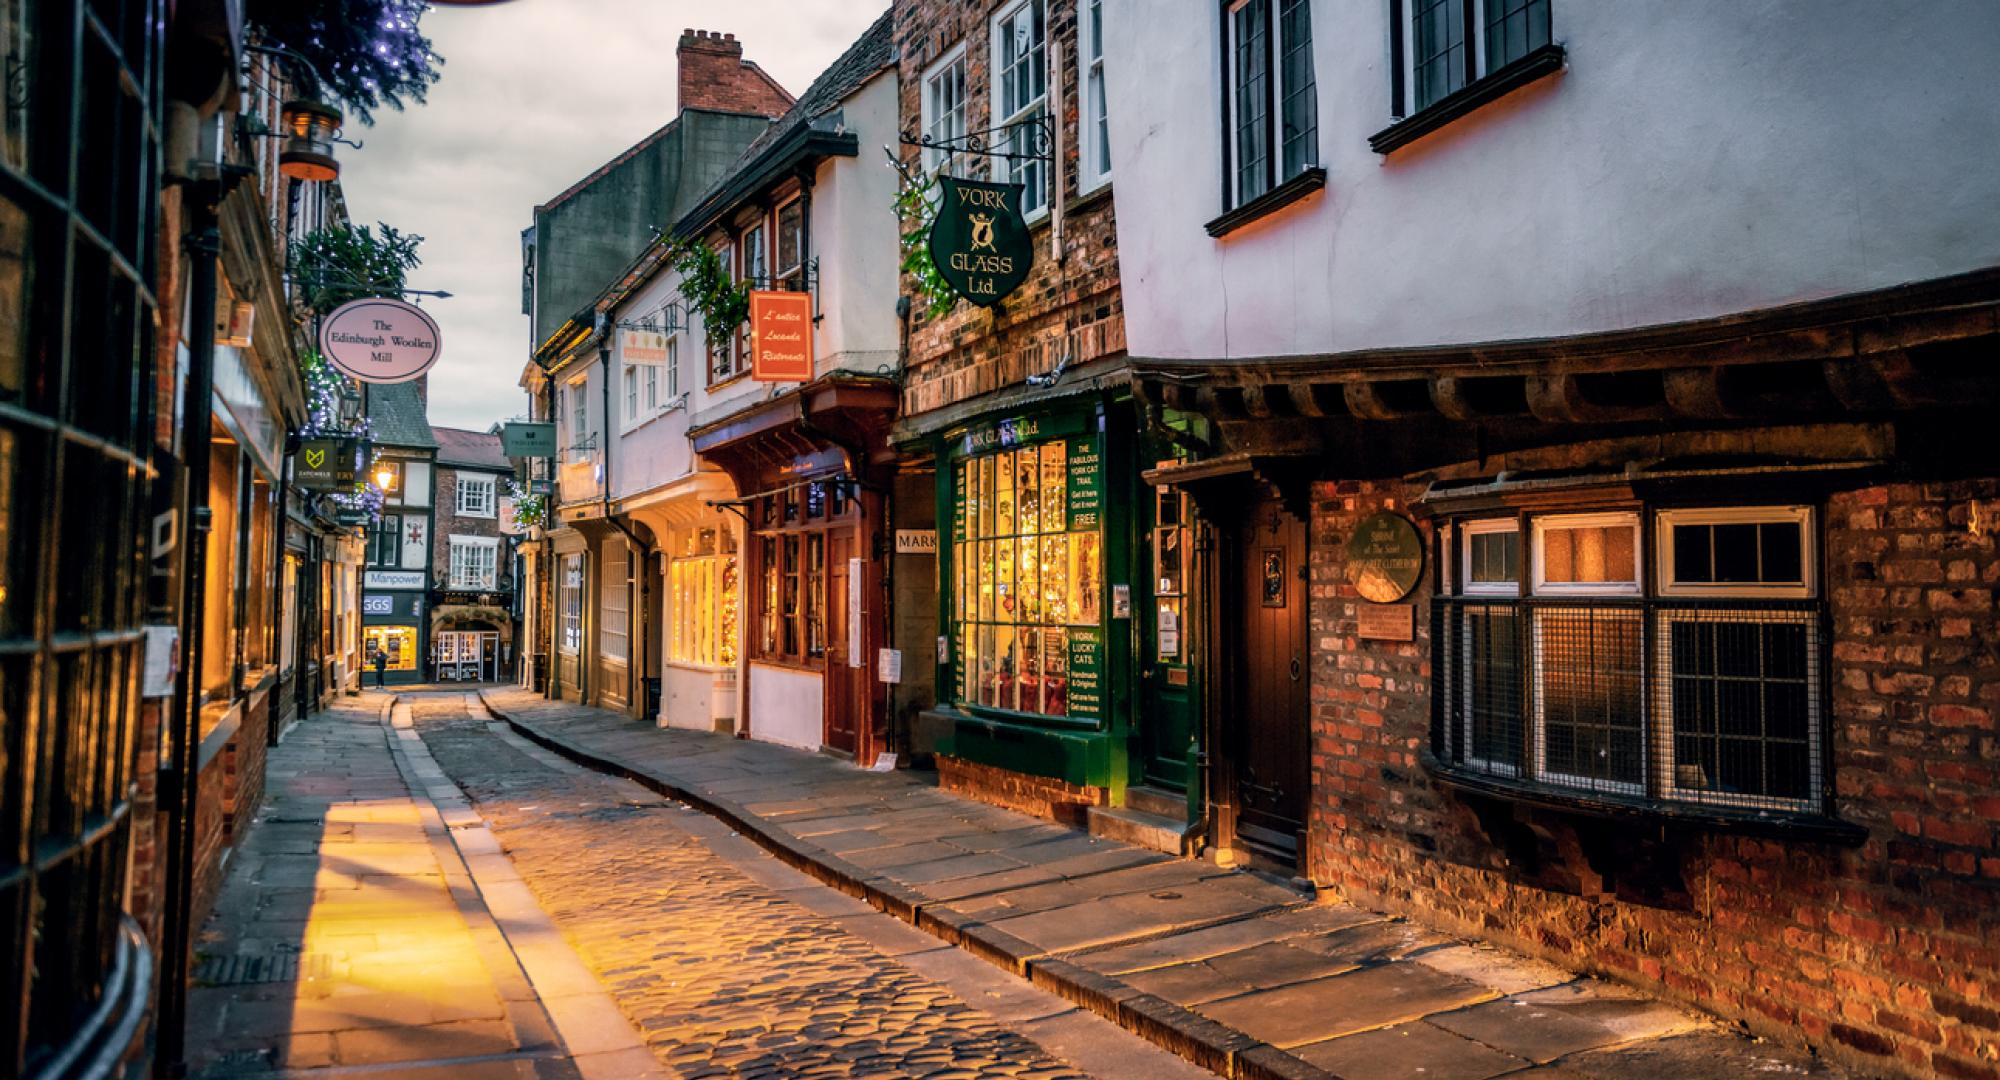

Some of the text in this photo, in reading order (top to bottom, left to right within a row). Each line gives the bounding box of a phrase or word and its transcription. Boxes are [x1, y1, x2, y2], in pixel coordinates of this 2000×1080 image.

[957, 187, 1009, 211] YORK
[951, 253, 1012, 273] GLASS
[968, 276, 996, 294] Ltd.
[372, 320, 392, 331] The
[332, 332, 432, 349] Edinburgh Woollen
[764, 329, 800, 341] Locanda
[371, 352, 392, 362] Mill
[761, 350, 805, 361] Ristorante
[1079, 444, 1089, 453] THE
[1070, 454, 1098, 464] FABULOUS
[1071, 465, 1098, 475] YORK CAT
[1077, 477, 1092, 485] TRAIL
[1075, 513, 1096, 525] FREE
[371, 574, 421, 585] Manpower
[1075, 632, 1094, 641] YORK
[1072, 643, 1096, 652] LUCKY
[1071, 671, 1098, 679] Handmade
